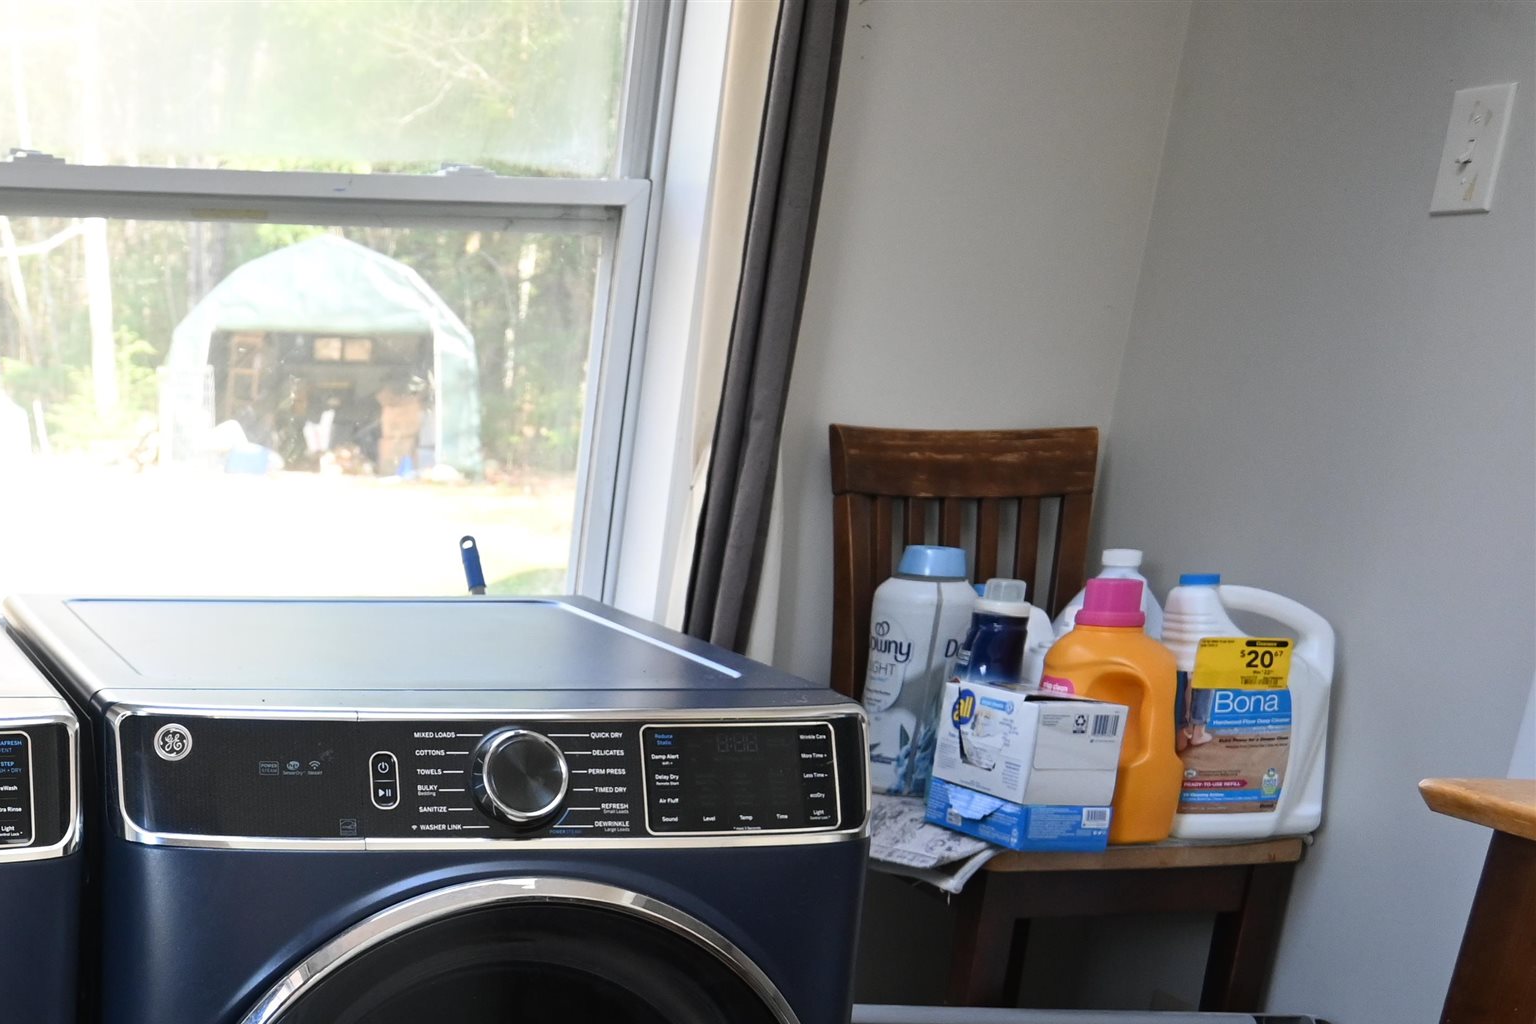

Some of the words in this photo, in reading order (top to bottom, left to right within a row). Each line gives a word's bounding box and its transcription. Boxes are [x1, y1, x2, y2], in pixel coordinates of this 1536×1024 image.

[870, 637, 911, 663] owny
[953, 696, 973, 721] all
[1214, 690, 1279, 713] Bona
